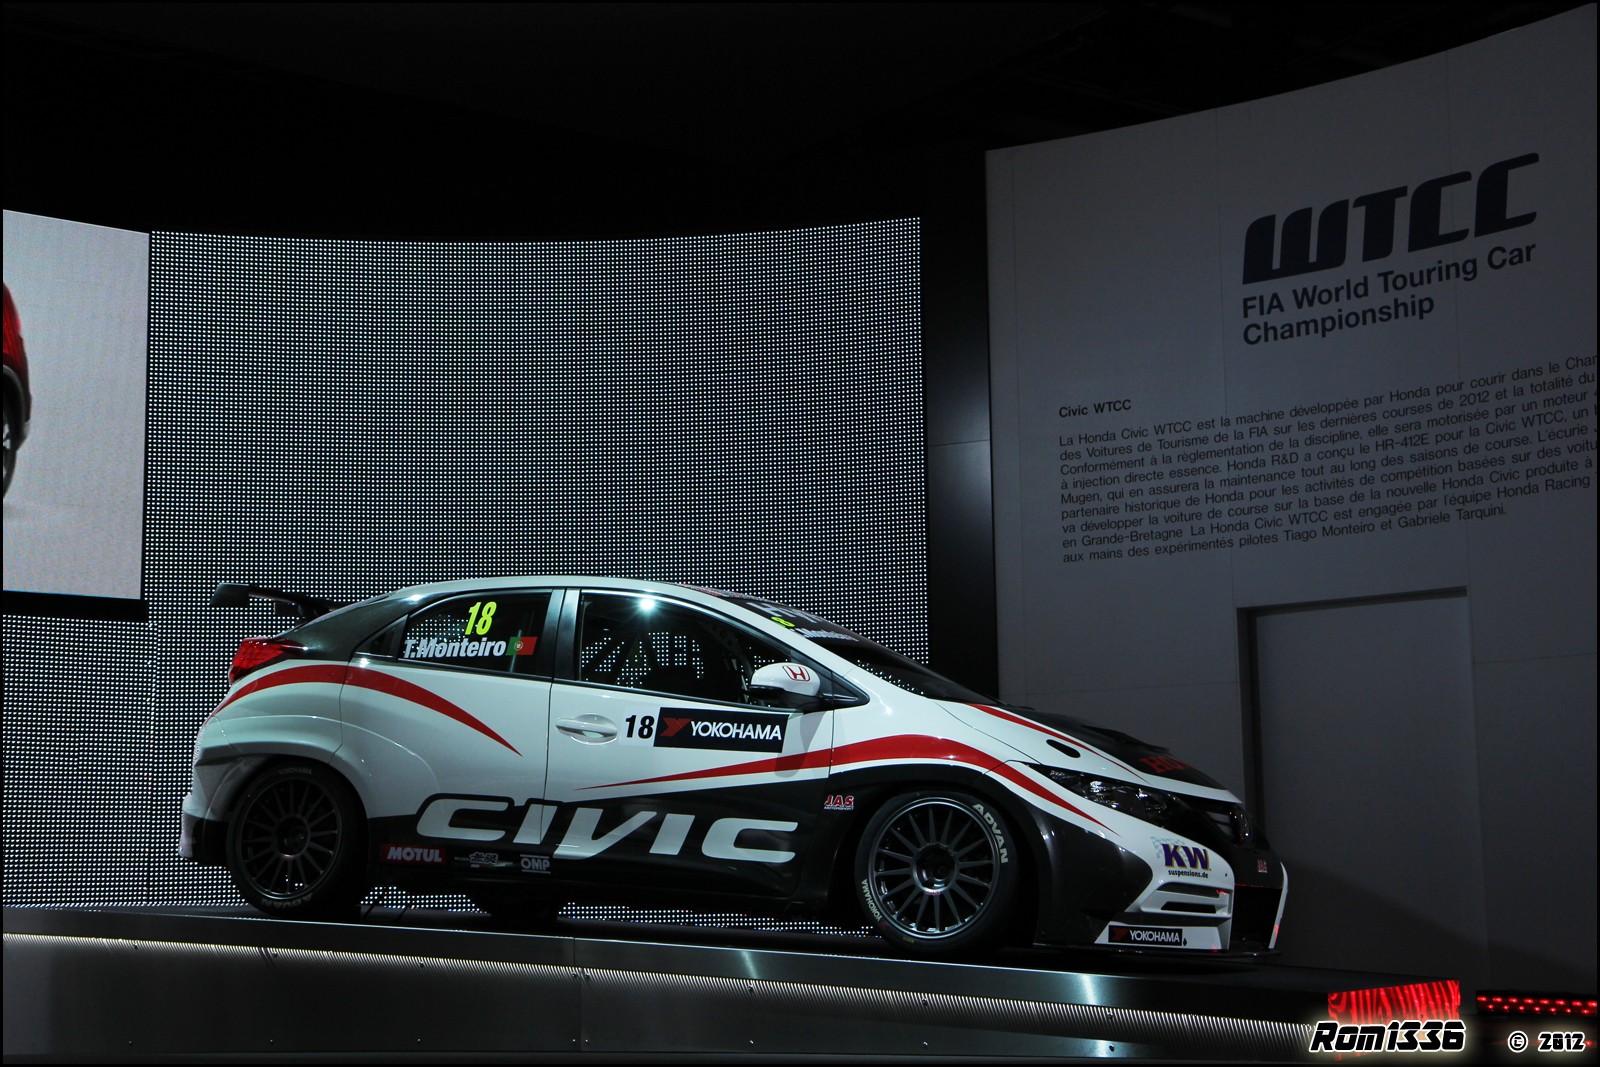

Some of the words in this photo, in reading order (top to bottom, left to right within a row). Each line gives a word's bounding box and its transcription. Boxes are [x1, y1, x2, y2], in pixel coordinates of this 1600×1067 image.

[1242, 152, 1539, 284] WTCC
[1242, 292, 1285, 319] FIA
[1292, 275, 1369, 309] World
[1377, 256, 1478, 293] Touring
[1487, 243, 1536, 270] Car
[1243, 296, 1434, 345] Championship
[1058, 405, 1089, 418] Civic
[1093, 399, 1132, 414] WTCC
[1059, 436, 1074, 447] La
[1078, 430, 1117, 445] Honda
[1121, 426, 1149, 440] Civic
[1153, 420, 1192, 436] WTCC
[1196, 418, 1216, 431] est
[1220, 416, 1231, 428] la
[1236, 409, 1285, 426] machine
[1289, 398, 1359, 418] développée
[1364, 395, 1385, 409] par
[1389, 386, 1431, 403] Honda
[1436, 381, 1465, 398] pour
[1470, 371, 1507, 389] courir
[1511, 366, 1544, 381] dans
[1548, 361, 1560, 374] le
[1060, 450, 1082, 461] des
[1086, 445, 1133, 458] Voitures
[1137, 441, 1153, 453] de
[1157, 436, 1209, 450] Tourisme
[1213, 431, 1229, 444] de
[1233, 429, 1244, 441] la
[1249, 425, 1269, 439] FIA
[1273, 424, 1293, 436] sur
[1297, 421, 1316, 432] les
[1320, 412, 1377, 429] dernières
[1382, 403, 1433, 420] courses
[1437, 398, 1454, 411] de
[1459, 390, 1490, 407] 2012
[1495, 388, 1508, 401] et
[1513, 385, 1524, 398] la
[1530, 374, 1574, 395] totalité
[1578, 371, 1595, 385] du
[1060, 456, 1145, 476] Conformément
[1150, 455, 1158, 466] à
[1162, 453, 1173, 465] la
[1268, 439, 1284, 452] de
[1289, 437, 1300, 449] la
[1367, 424, 1389, 438] elle
[1394, 421, 1422, 434] sera
[1427, 408, 1490, 429] motorisée
[1495, 404, 1517, 420] par
[1522, 401, 1538, 413] un
[1543, 391, 1589, 409] moteur
[1061, 479, 1068, 490] à
[1072, 475, 1120, 490] injection
[1124, 470, 1164, 484] directe
[1169, 464, 1222, 479] essence.
[1227, 457, 1267, 473] Honda
[1271, 452, 1299, 466] R&D
[1304, 452, 1312, 462] a
[1317, 447, 1355, 461] conçu
[1359, 443, 1371, 454] le
[1375, 432, 1430, 452] HR-412E
[1435, 430, 1464, 446] pour
[1469, 425, 1480, 438] la
[1485, 419, 1516, 435] Civic
[1572, 408, 1589, 420] un
[1061, 492, 1103, 506] Mugen,
[1107, 488, 1124, 502] qui
[1129, 488, 1144, 498] en
[1148, 482, 1200, 496] assurera
[1204, 478, 1215, 490] la
[1219, 470, 1296, 488] maintenance
[1301, 464, 1325, 478] tout
[1330, 464, 1345, 474] au
[1350, 459, 1376, 472] long
[1380, 455, 1404, 468] des
[1409, 447, 1459, 464] saisons
[1463, 442, 1480, 455] de
[1485, 435, 1533, 452] course.
[1061, 504, 1120, 522] partenaire
[1124, 498, 1181, 513] historique
[1185, 495, 1201, 507] de
[1205, 490, 1245, 505] Honda
[1249, 487, 1277, 502] pour
[1281, 484, 1300, 496] les
[1305, 476, 1355, 493] activités
[1359, 473, 1375, 486] de
[1380, 464, 1453, 483] compétition
[1457, 456, 1506, 472] basées
[1511, 451, 1532, 464] sur
[1536, 446, 1562, 460] des
[1062, 524, 1076, 534] va
[1080, 518, 1144, 532] développer
[1148, 514, 1159, 526] la
[1163, 511, 1203, 524] voiture
[1207, 507, 1223, 520] de
[1227, 504, 1269, 518] course
[1274, 501, 1294, 512] sur
[1298, 498, 1309, 509] la
[1313, 495, 1345, 508] base
[1349, 491, 1365, 503] de
[1370, 488, 1381, 500] la
[1386, 481, 1437, 498] nouvelle
[1442, 474, 1484, 490] Honda
[1489, 468, 1521, 484] Civic
[1525, 460, 1579, 481] produite
[1584, 455, 1593, 469] à
[1062, 539, 1077, 549] en
[1190, 525, 1206, 537] La
[1210, 520, 1250, 534] Honda
[1254, 516, 1283, 530] Civic
[1288, 510, 1328, 526] WTCC
[1333, 508, 1353, 521] est
[1358, 500, 1412, 519] engagée
[1417, 498, 1439, 513] par
[1497, 482, 1540, 499] Honda
[1544, 475, 1591, 492] Racing
[1063, 553, 1084, 563] aux
[1089, 548, 1123, 561] mains
[1127, 546, 1150, 558] des
[1154, 536, 1234, 556] expérimentés
[1239, 533, 1279, 549] pilotes
[1283, 529, 1317, 543] Tiago
[1322, 521, 1376, 537] Monteiro
[1380, 518, 1393, 531] et
[1397, 511, 1451, 529] Gabriele
[1455, 502, 1507, 521] Tarquini.
[403, 636, 506, 659] T.Monteiro
[464, 601, 497, 636] 18
[625, 714, 655, 739] 18
[690, 720, 782, 741] YOKOHAMA
[387, 846, 443, 863] MOTUL
[416, 797, 798, 863] CIVIC
[972, 803, 1009, 864] ADVAN
[1161, 843, 1210, 870] KW
[520, 857, 551, 872] OMP
[1168, 869, 1209, 879] suspensions.de
[861, 878, 883, 922] YOKOHAMA
[1129, 929, 1181, 943] YOKOHAMA
